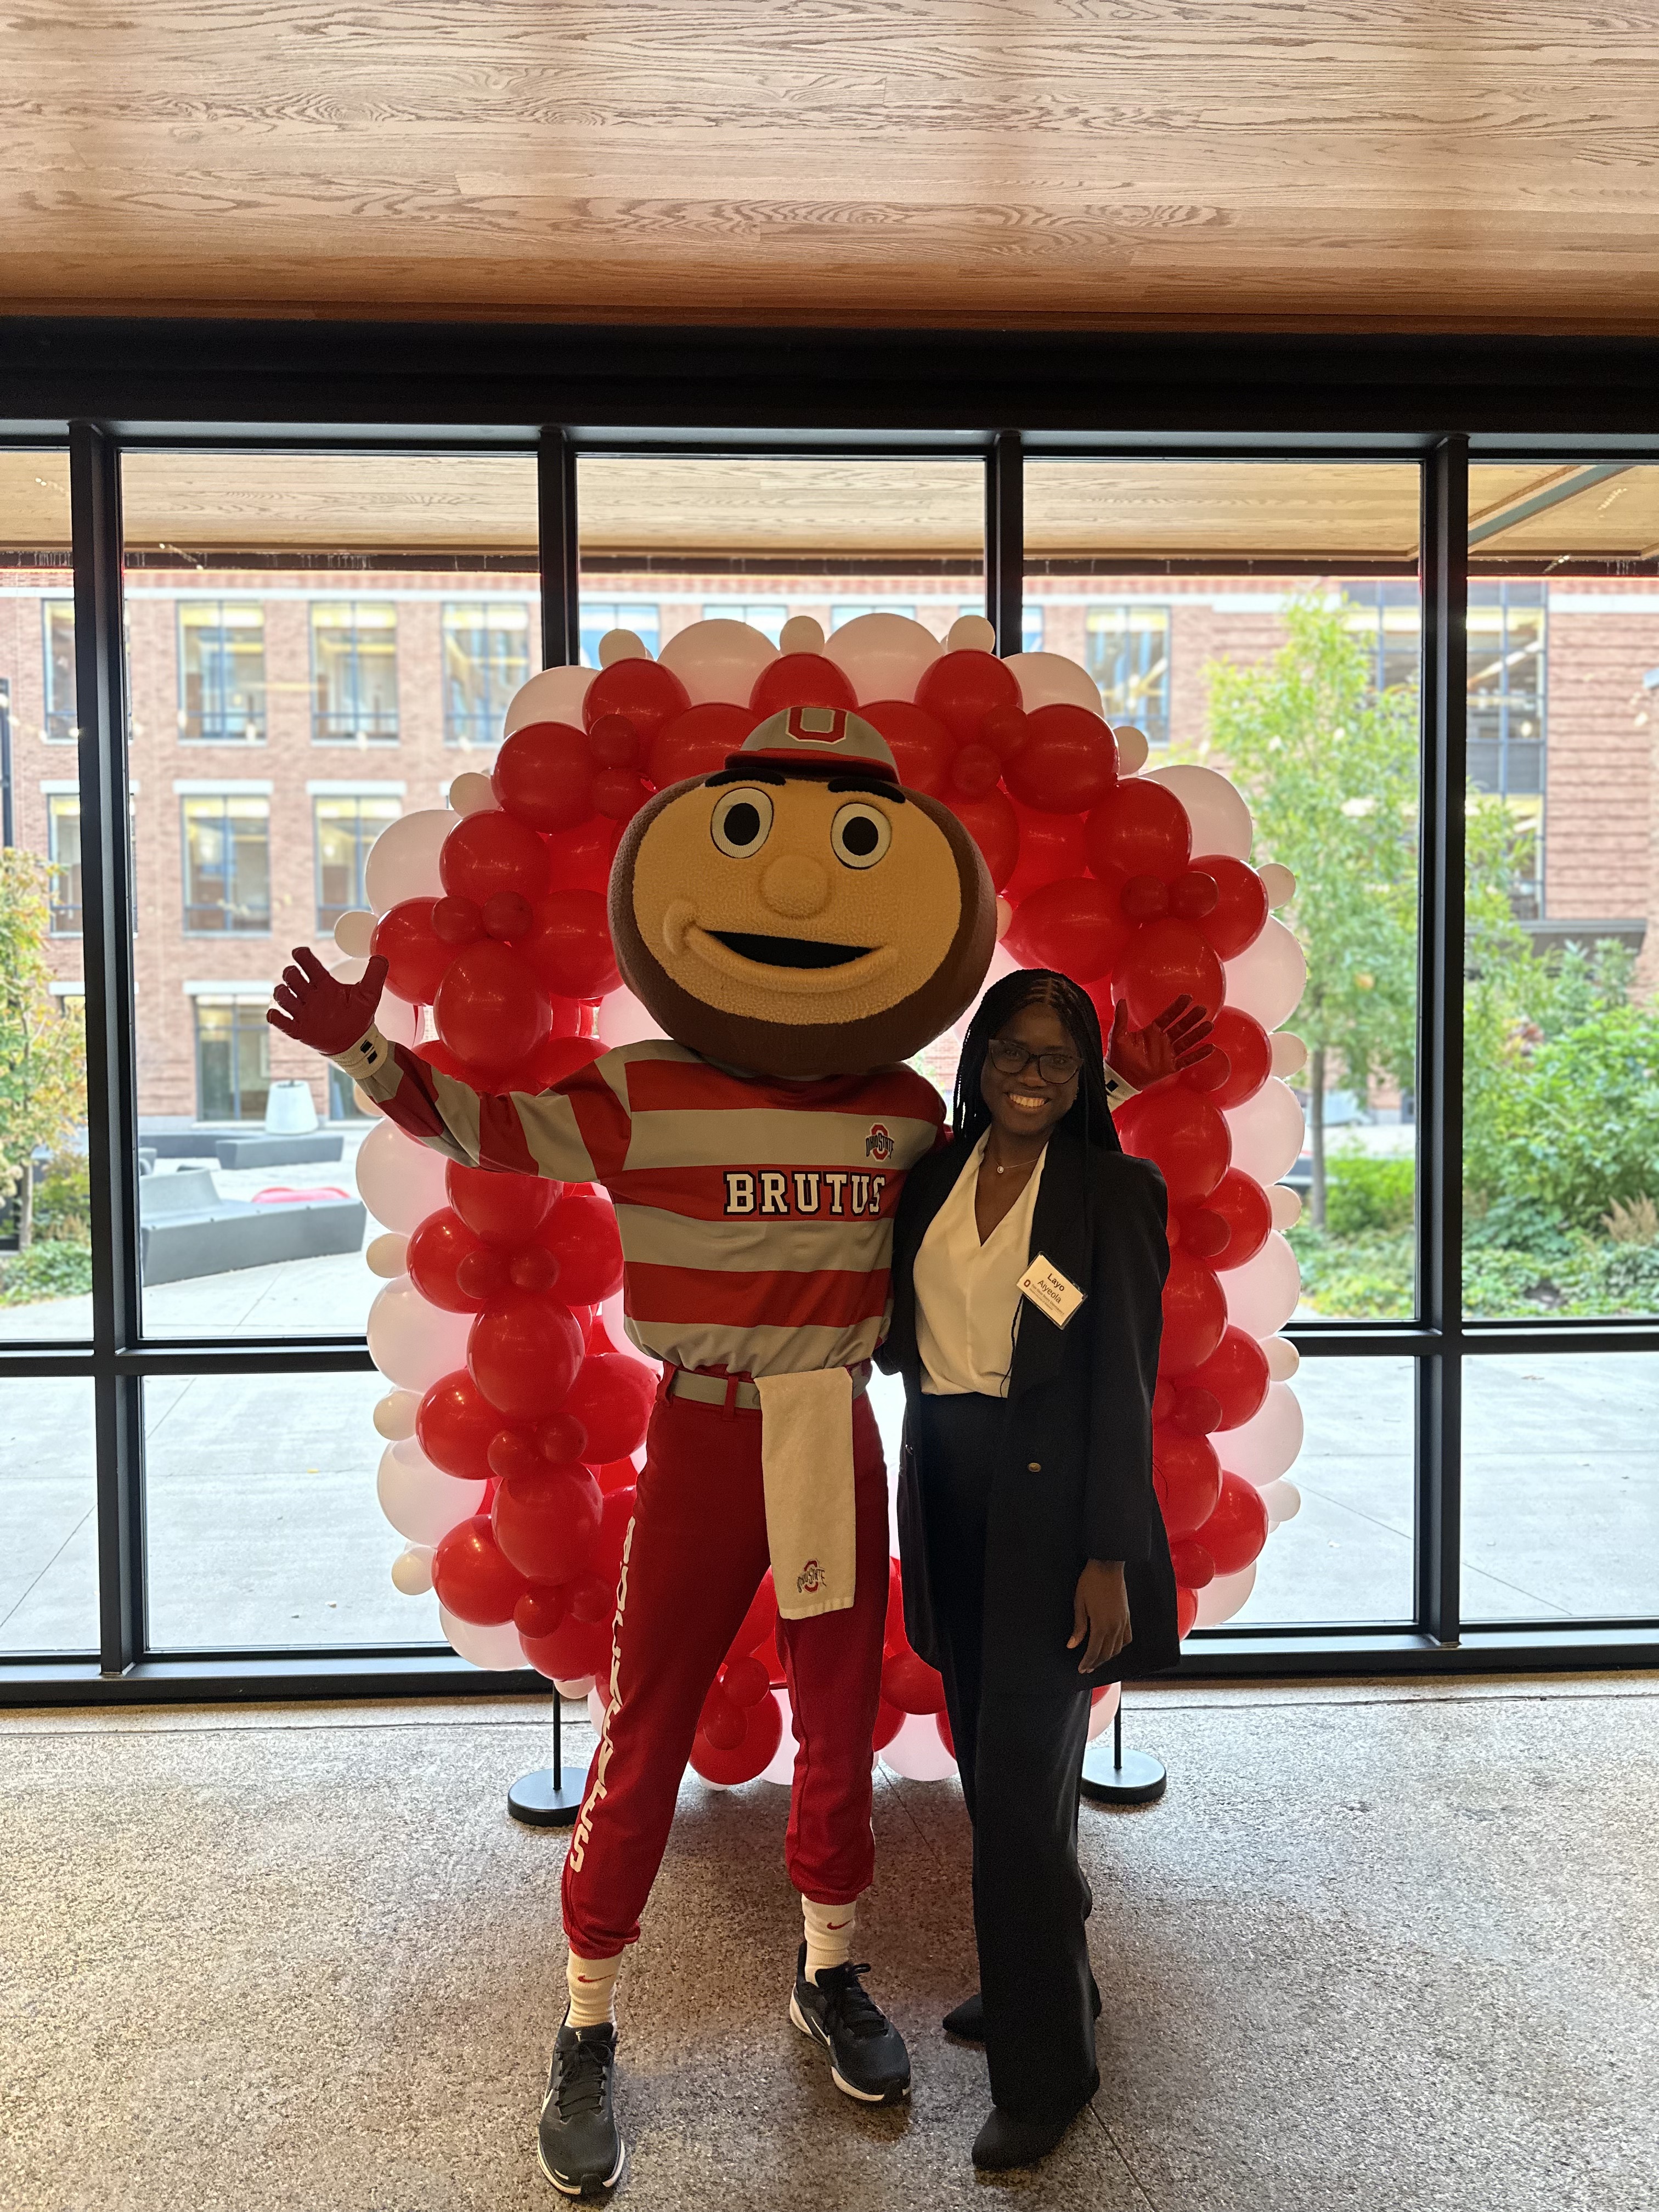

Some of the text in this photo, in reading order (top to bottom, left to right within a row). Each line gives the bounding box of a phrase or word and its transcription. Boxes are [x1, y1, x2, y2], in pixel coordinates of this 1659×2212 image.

[866, 1132, 895, 1160] OHIO STATE
[723, 1170, 885, 1216] BRUTUS
[1047, 1273, 1065, 1291] Layo
